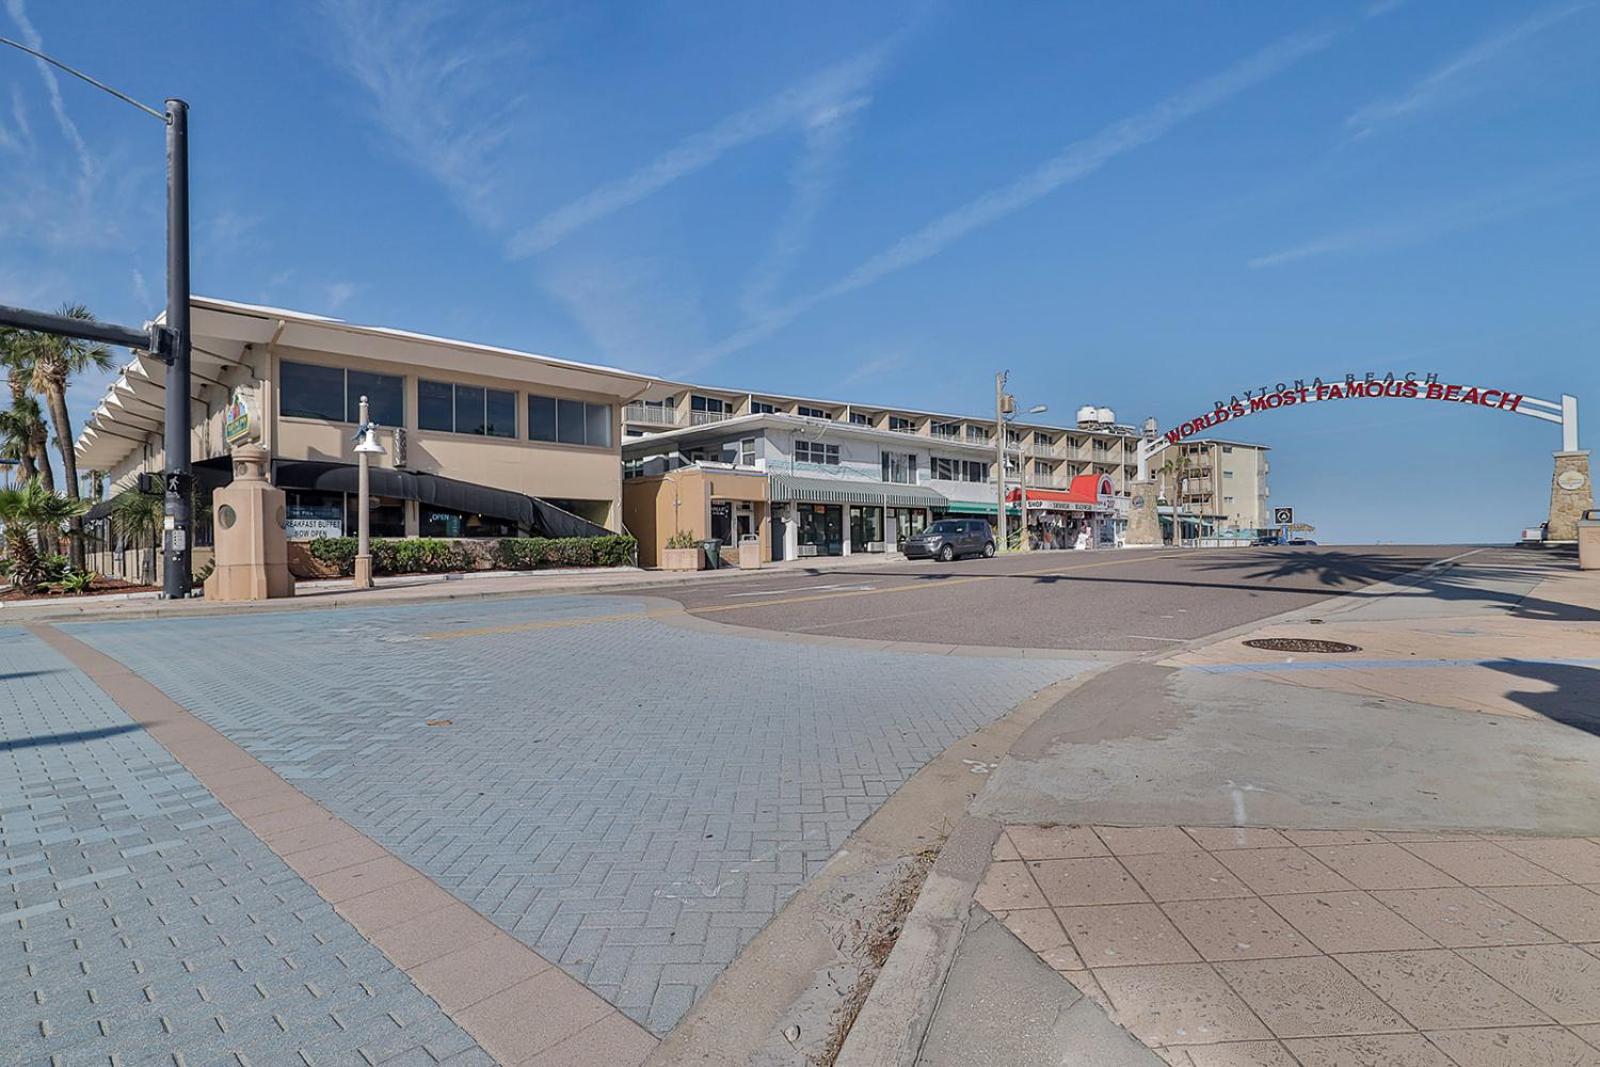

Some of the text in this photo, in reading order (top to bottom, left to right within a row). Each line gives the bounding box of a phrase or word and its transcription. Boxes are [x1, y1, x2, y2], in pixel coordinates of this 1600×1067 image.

[1214, 371, 1439, 410] DAYTONA BEACH
[1165, 381, 1523, 443] WORLD'S MOST FAMOUS BEACH
[285, 520, 317, 528] REAKFAST
[432, 513, 450, 521] OPEN
